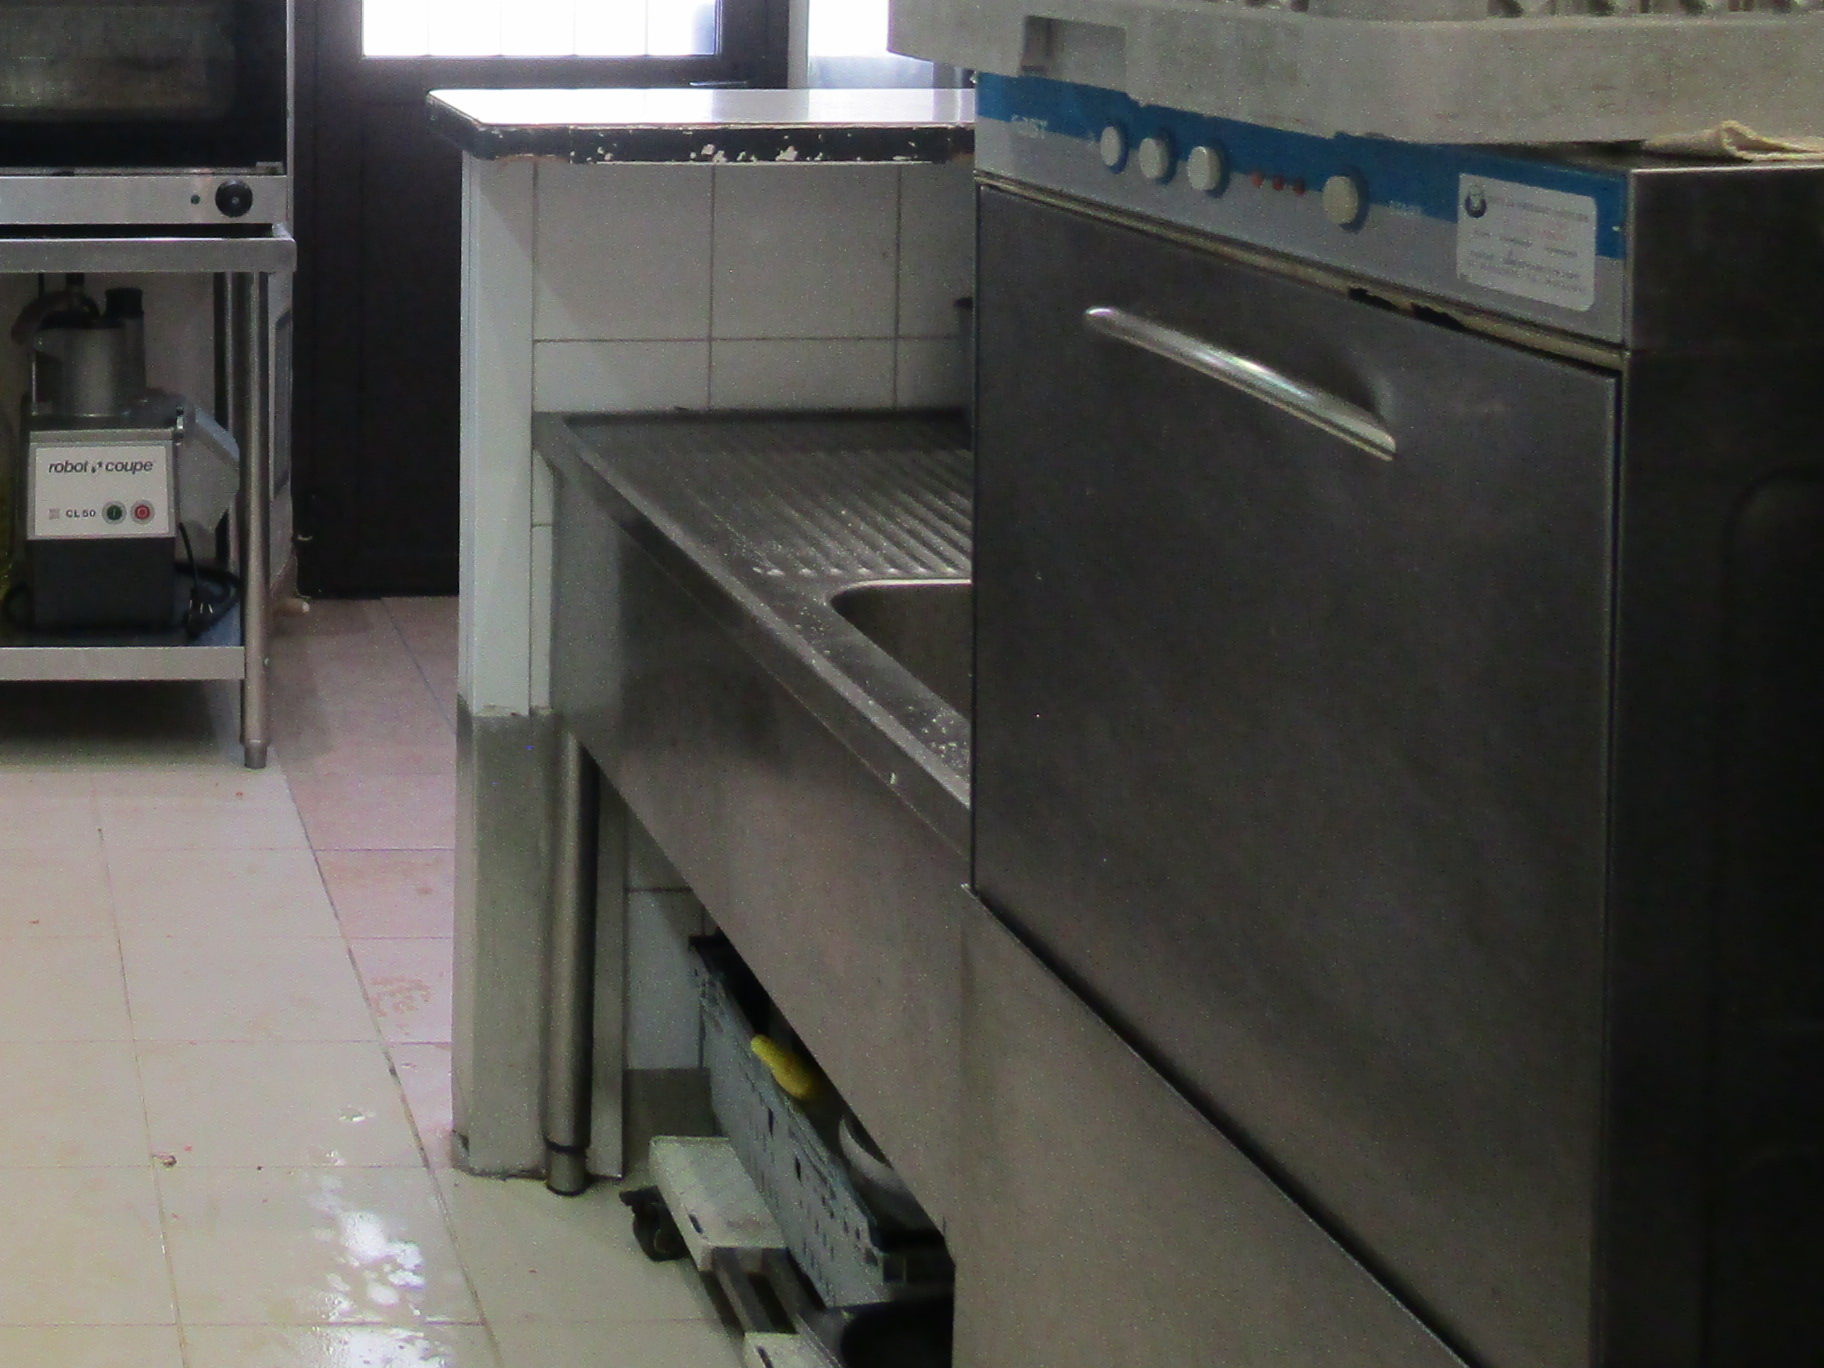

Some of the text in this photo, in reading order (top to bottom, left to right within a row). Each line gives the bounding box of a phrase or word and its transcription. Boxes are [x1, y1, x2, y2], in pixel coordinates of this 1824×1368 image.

[48, 460, 154, 475] robot coupe
[65, 509, 96, 518] CL 50
